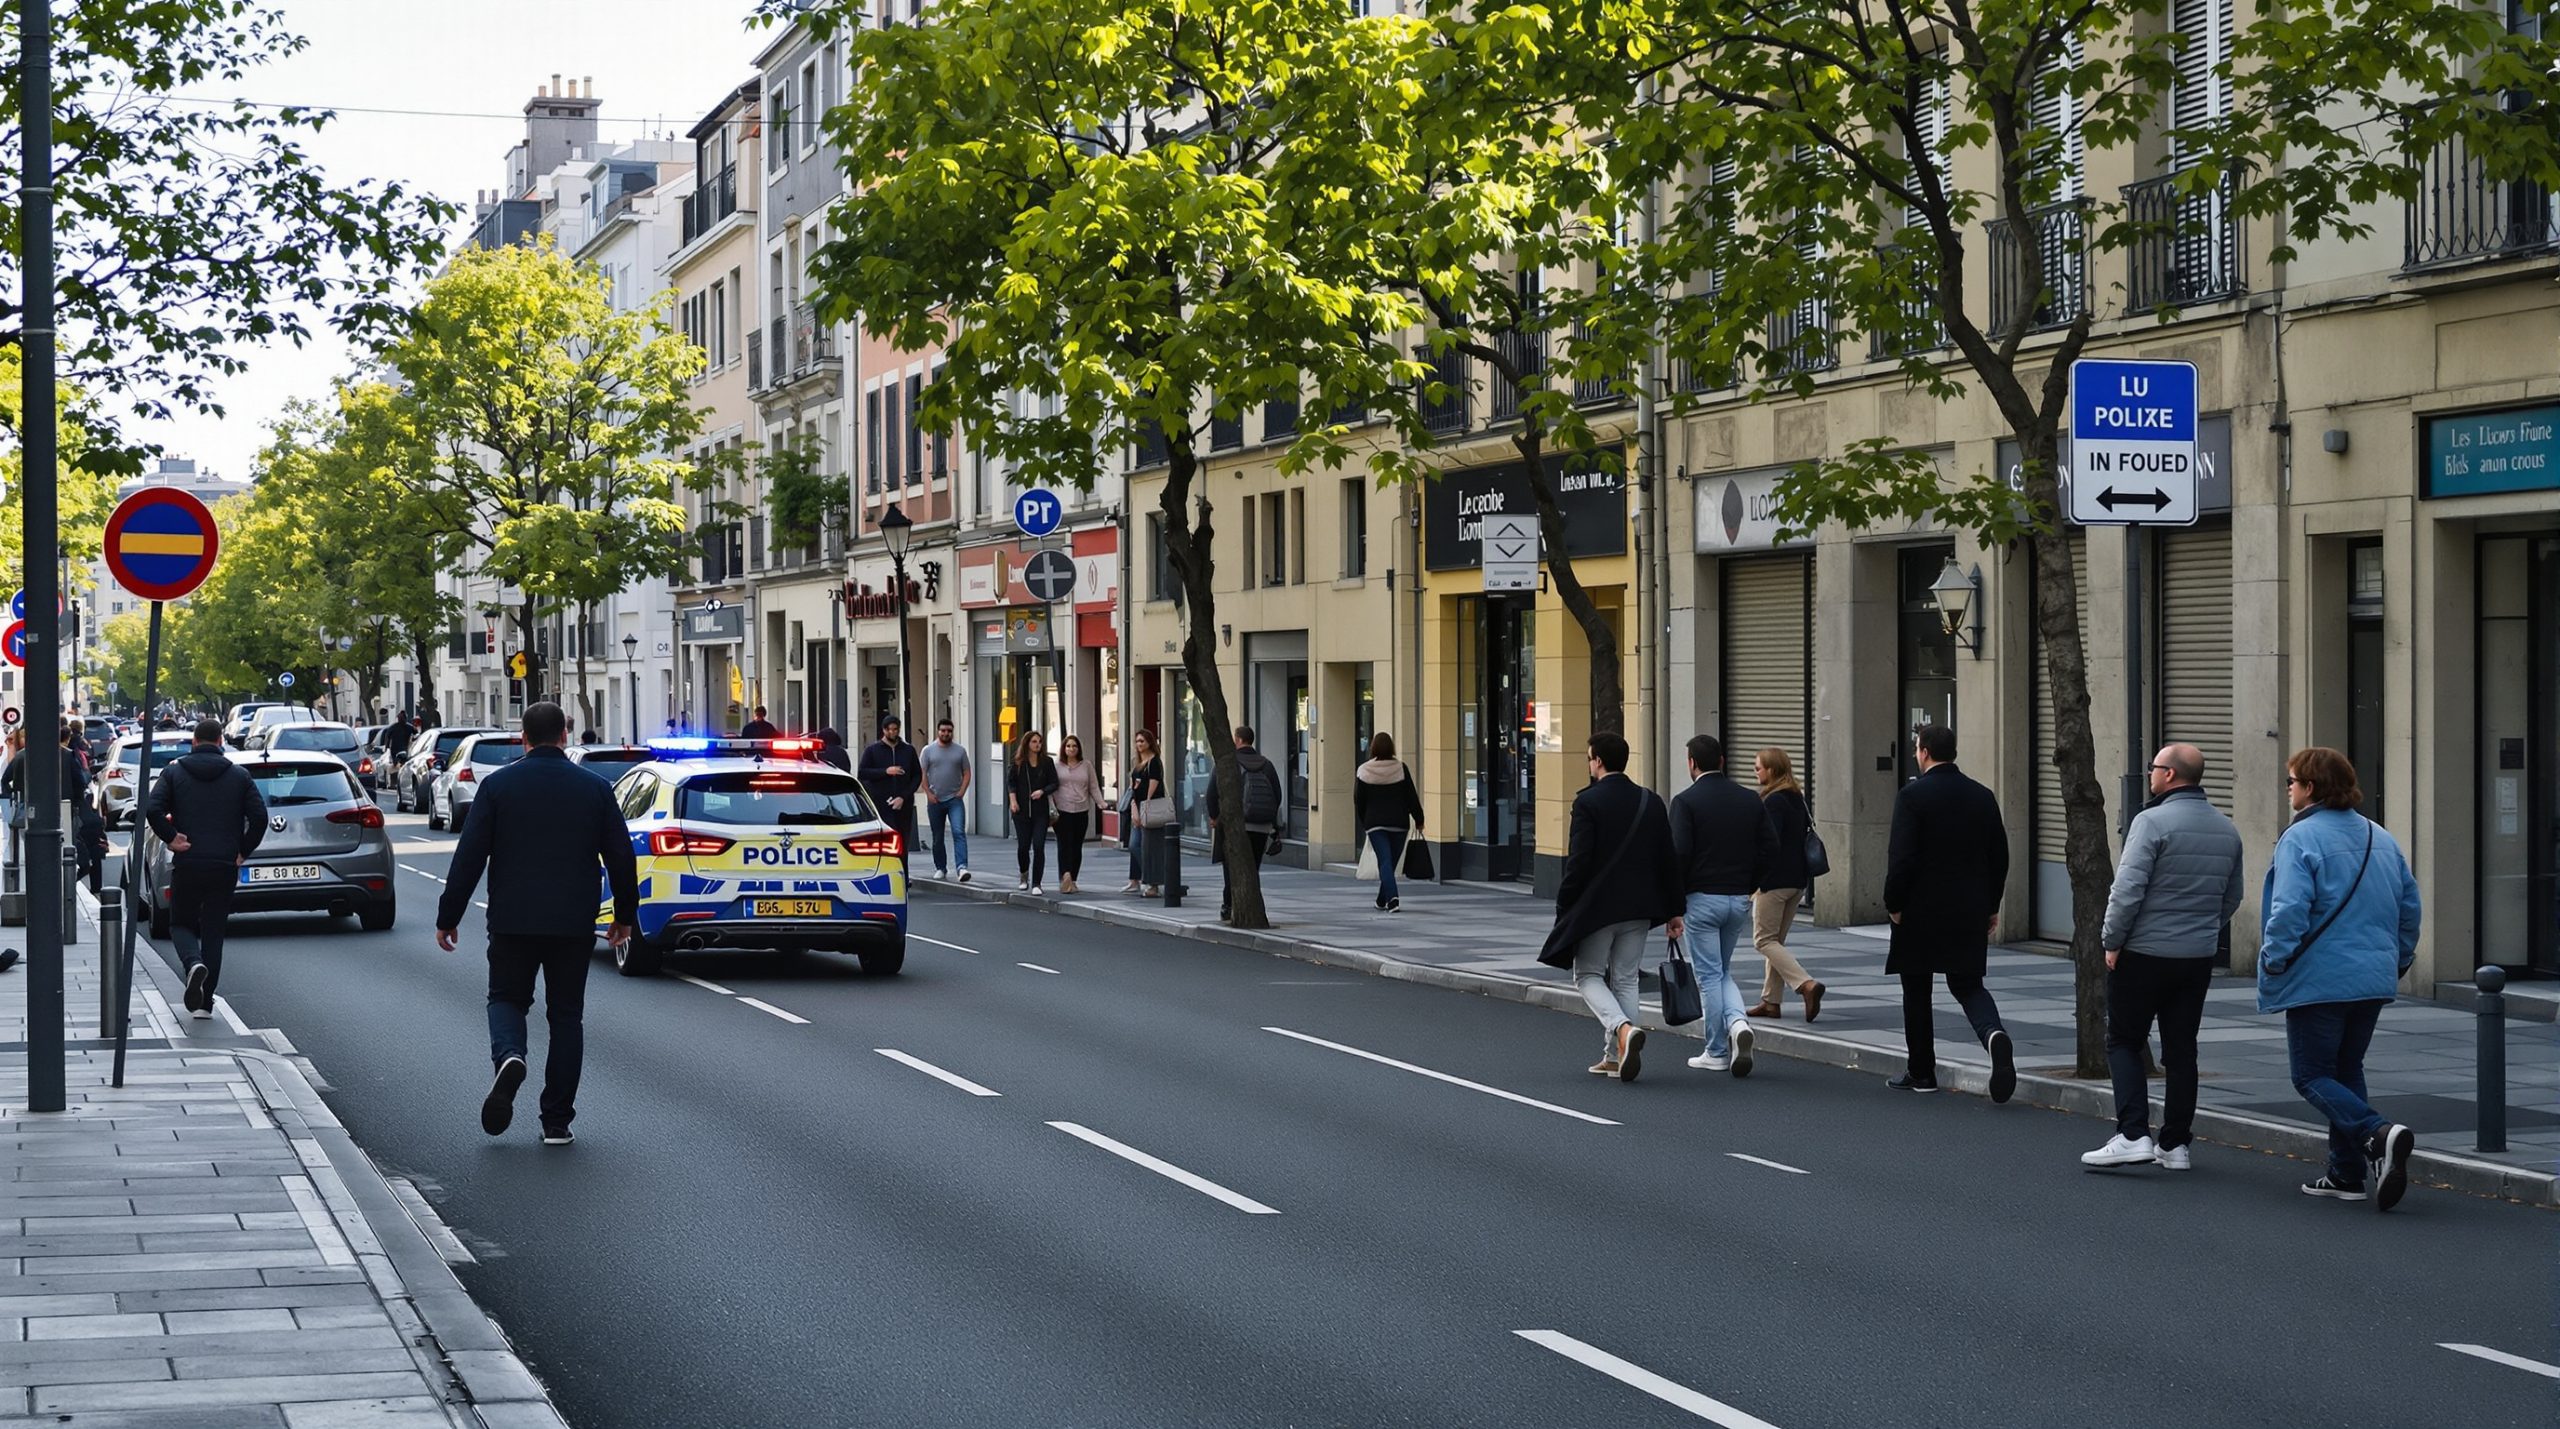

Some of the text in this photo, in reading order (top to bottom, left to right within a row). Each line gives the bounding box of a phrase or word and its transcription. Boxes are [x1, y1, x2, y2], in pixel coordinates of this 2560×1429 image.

[2120, 375, 2149, 398] LU
[2089, 451, 2111, 472] IN
[2119, 452, 2189, 473] FOUED
[742, 846, 839, 866] POLICE
